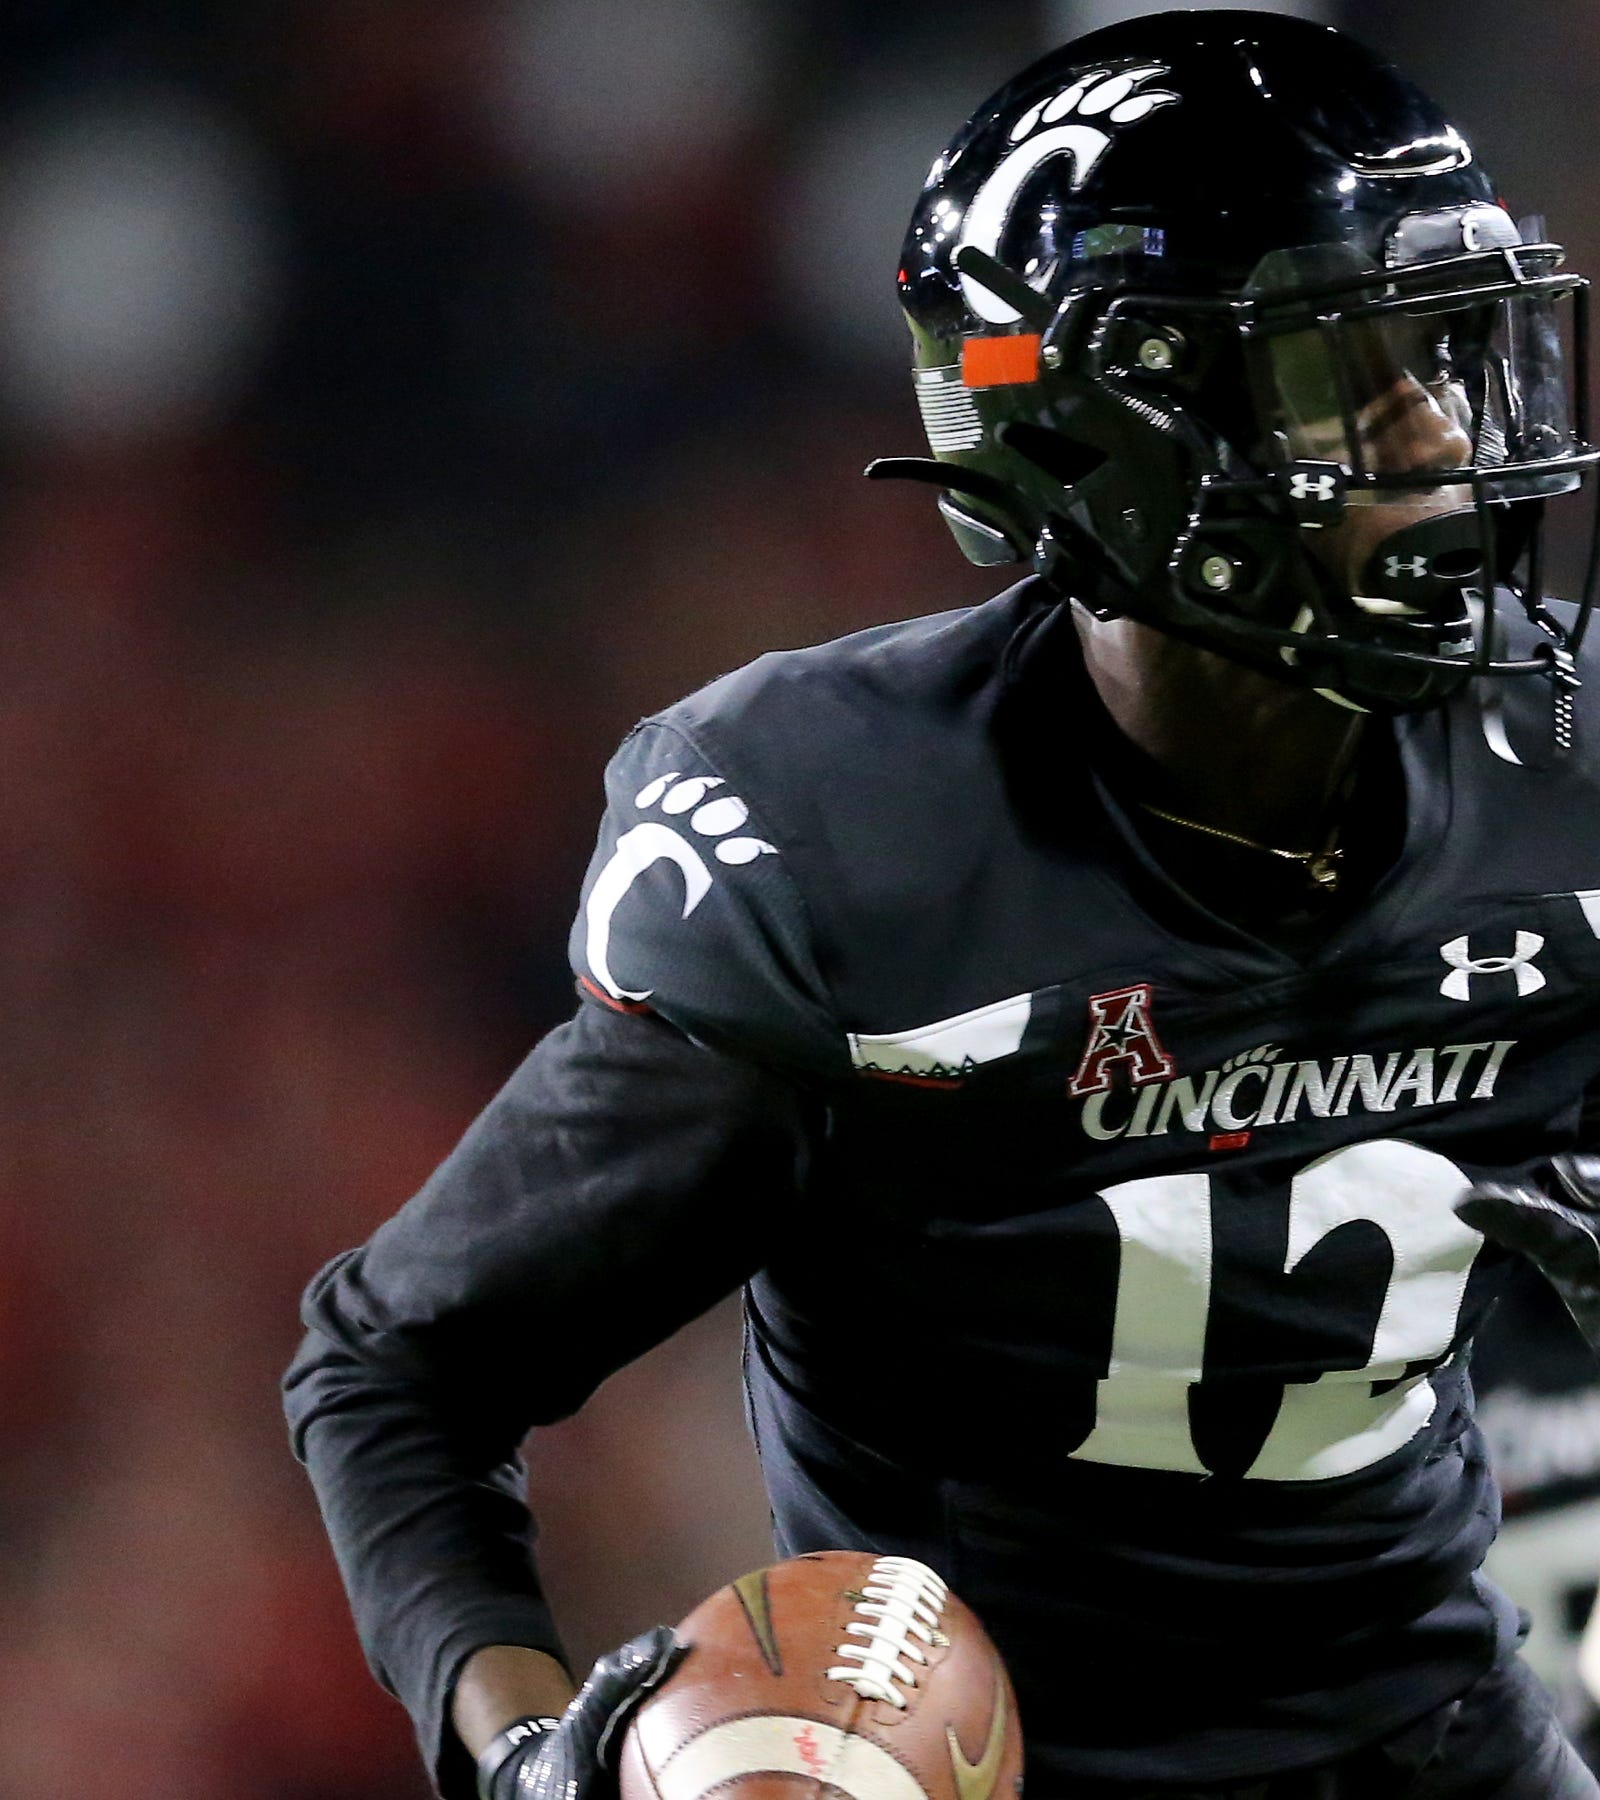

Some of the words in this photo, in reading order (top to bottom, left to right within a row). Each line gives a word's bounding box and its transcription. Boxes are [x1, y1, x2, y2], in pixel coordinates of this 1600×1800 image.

[1068, 984, 1176, 1096] A
[1081, 1040, 1518, 1140] CINCINNATI
[1067, 1137, 1485, 1482] 12
